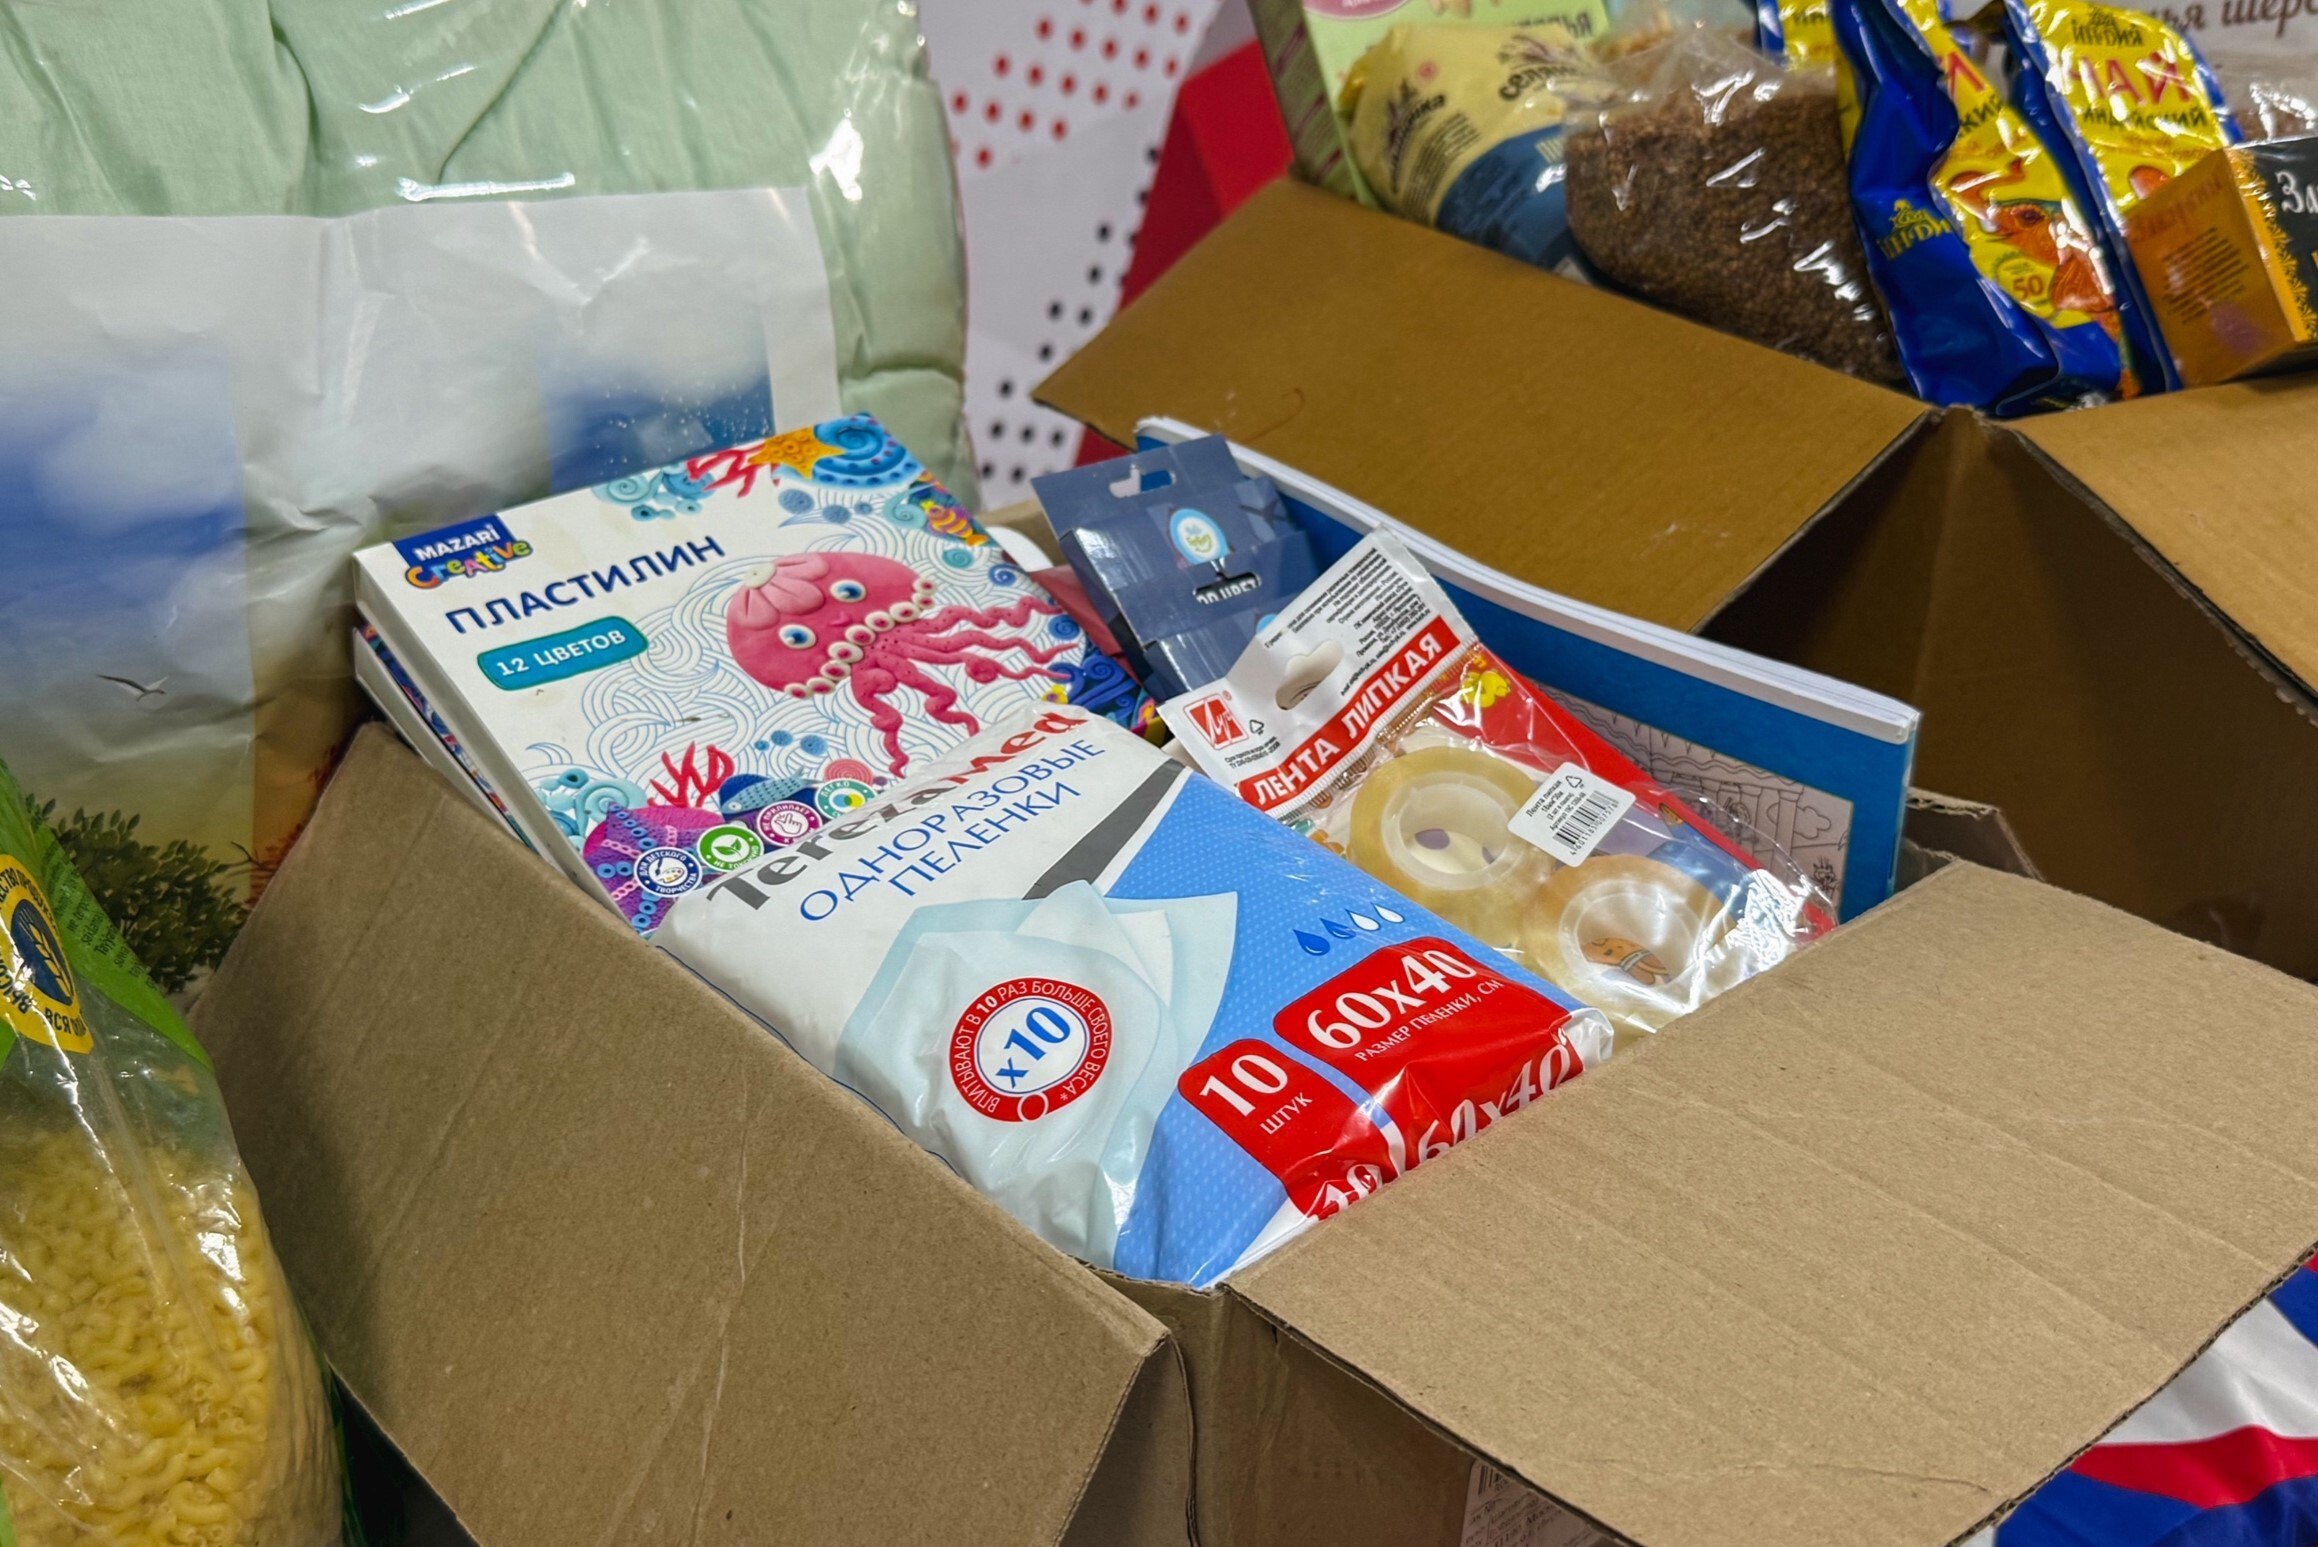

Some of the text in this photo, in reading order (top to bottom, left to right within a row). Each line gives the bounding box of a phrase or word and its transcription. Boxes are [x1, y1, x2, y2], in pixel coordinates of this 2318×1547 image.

[2066, 50, 2191, 105] ЧАЙ
[2012, 274, 2043, 301] 50
[405, 538, 533, 589] Creative
[444, 535, 725, 634] ПЛАСТИЛИН
[496, 629, 626, 677] 12 ЦВЕТОВ
[1253, 736, 1341, 805] ЛЕНТА
[1341, 631, 1443, 737] ЛИПКАЯ
[800, 739, 1106, 921] ОДНОРАЗОВЫЕ
[1525, 796, 1545, 817] Лента
[889, 781, 1080, 897] ПЕЛЕНКИ
[977, 997, 997, 1014] 10
[997, 981, 1027, 1001] РАЗ
[1032, 981, 1095, 1012] БОЛЬШЕ
[1306, 950, 1478, 1050] 60x40
[44, 1007, 72, 1034] ВСЯ
[966, 1014, 981, 1026] В
[1088, 1008, 1108, 1059] СВОЕГО
[1355, 978, 1504, 1063] РАЗМЕР ПЕЛЕНКИ, СМ
[954, 1026, 1000, 1112] ВПИТЫВАЮТ
[1200, 1053, 1288, 1118] 10
[1260, 1092, 1312, 1136] ШТУК
